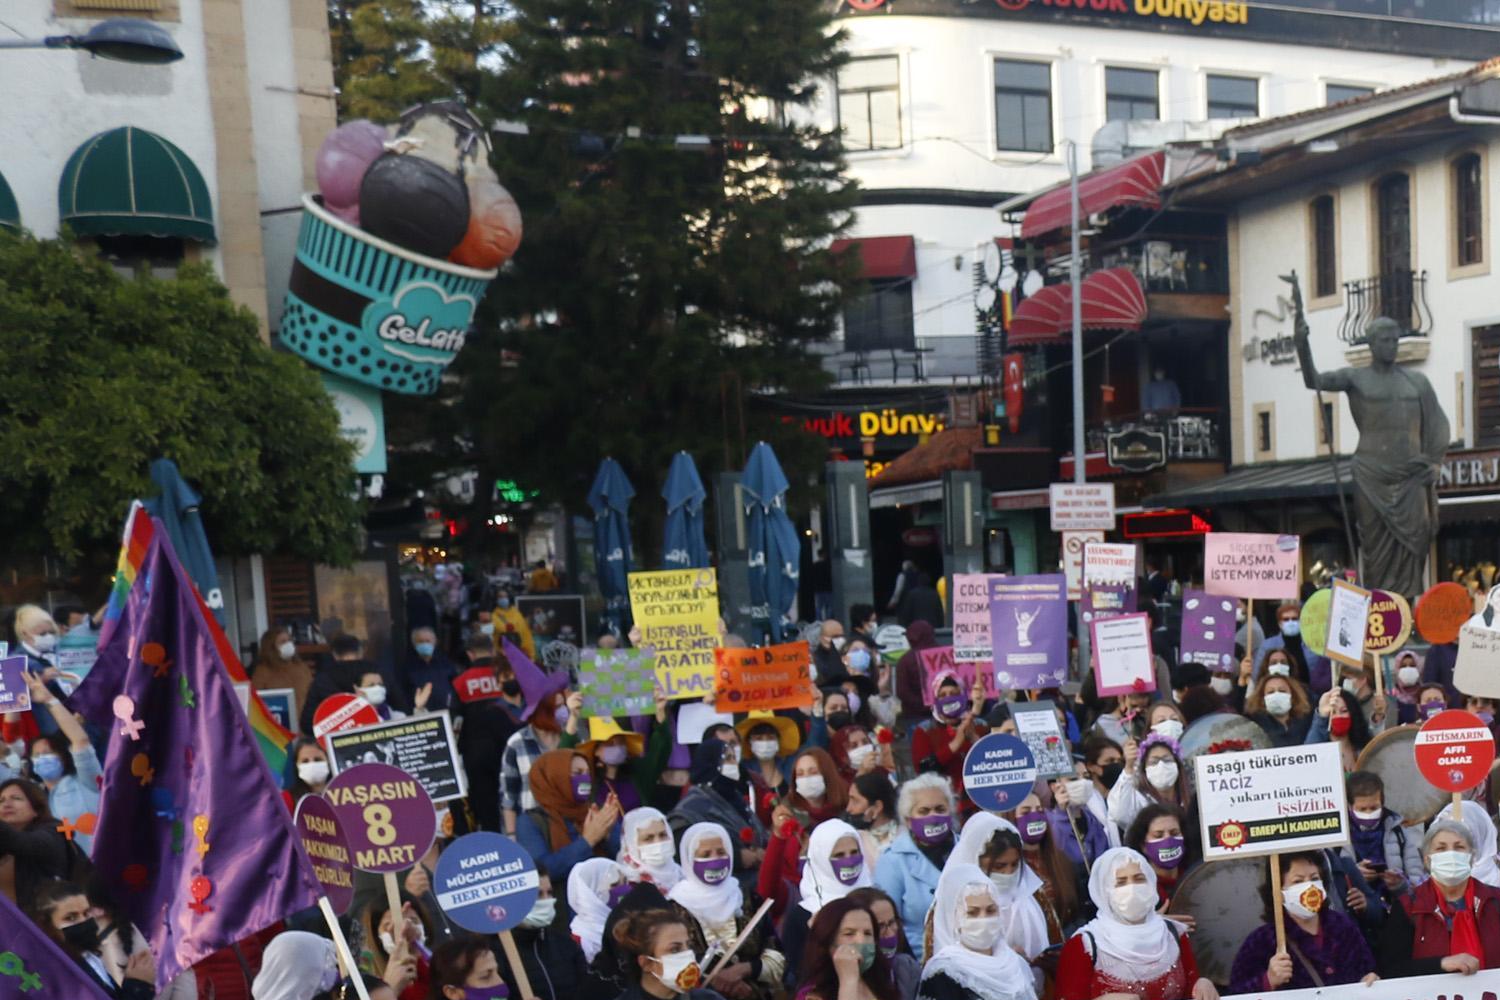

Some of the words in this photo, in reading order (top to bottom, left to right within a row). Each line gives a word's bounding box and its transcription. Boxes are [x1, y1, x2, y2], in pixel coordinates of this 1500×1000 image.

[1369, 613, 1385, 637] 8
[985, 749, 1013, 759] KADIN
[1437, 755, 1472, 766] OLMAZ
[1444, 745, 1466, 755] AFFI
[972, 757, 1028, 773] MÜCADELESİ
[1207, 760, 1245, 775] aşağı
[1249, 753, 1318, 770] tükürsem
[973, 775, 994, 785] HER
[995, 772, 1026, 783] YERDE
[1208, 775, 1253, 792] TACİZ
[327, 781, 417, 807] YAŞASIN
[1230, 791, 1271, 807] yukarı
[1274, 785, 1333, 800] tükürsem
[303, 813, 336, 837] YAŞAM
[363, 804, 397, 846] 8
[1250, 822, 1288, 837] EMEP'Lİ
[1289, 817, 1339, 833] KADINLAR
[356, 845, 416, 868] MART
[460, 851, 499, 869] KADIN
[446, 858, 523, 888] MÜCADELESİ
[452, 888, 481, 905] HER
[483, 877, 527, 898] YERDE
